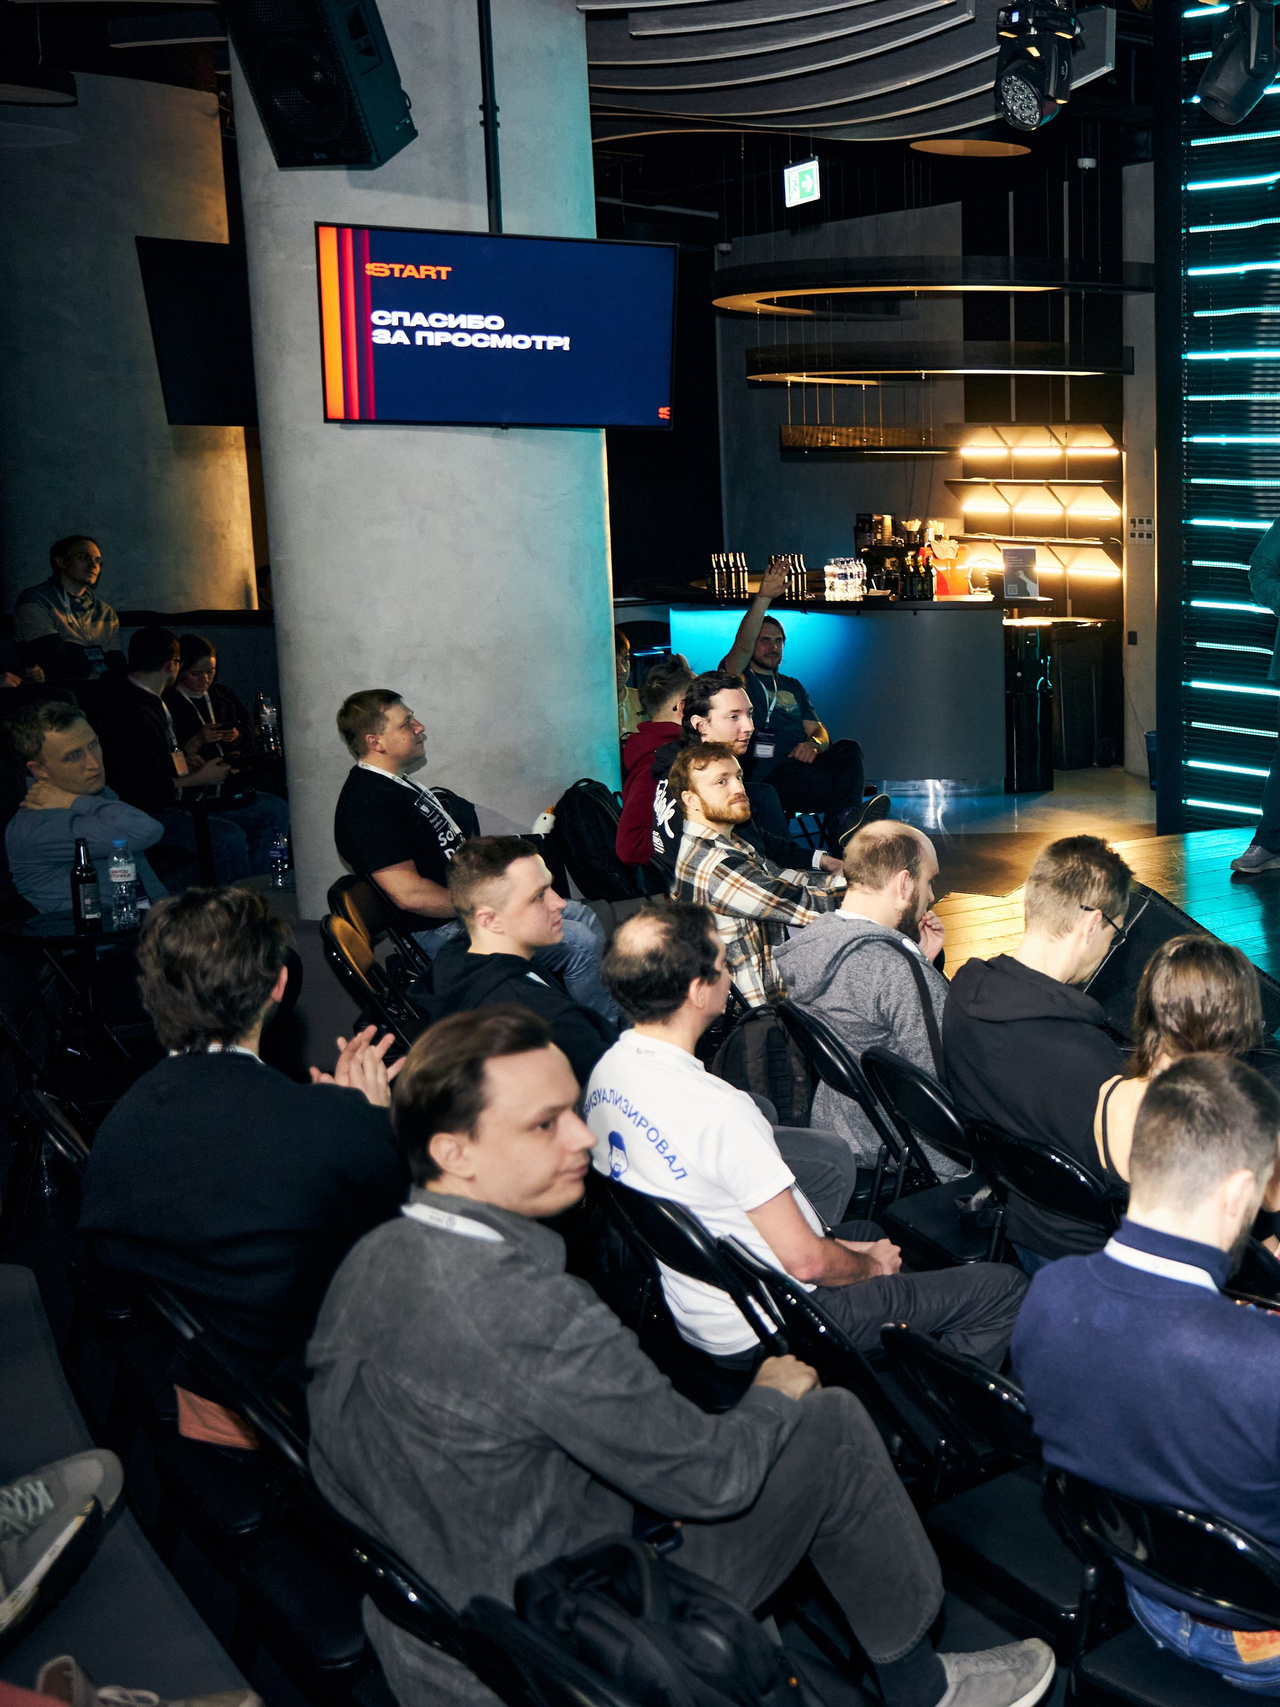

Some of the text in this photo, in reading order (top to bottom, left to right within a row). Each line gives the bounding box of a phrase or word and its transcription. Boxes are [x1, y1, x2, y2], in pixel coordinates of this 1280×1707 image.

[365, 262, 453, 281] START
[371, 310, 505, 332] СПАСИБО
[371, 329, 571, 351] ЗА ПРОСМОТР!
